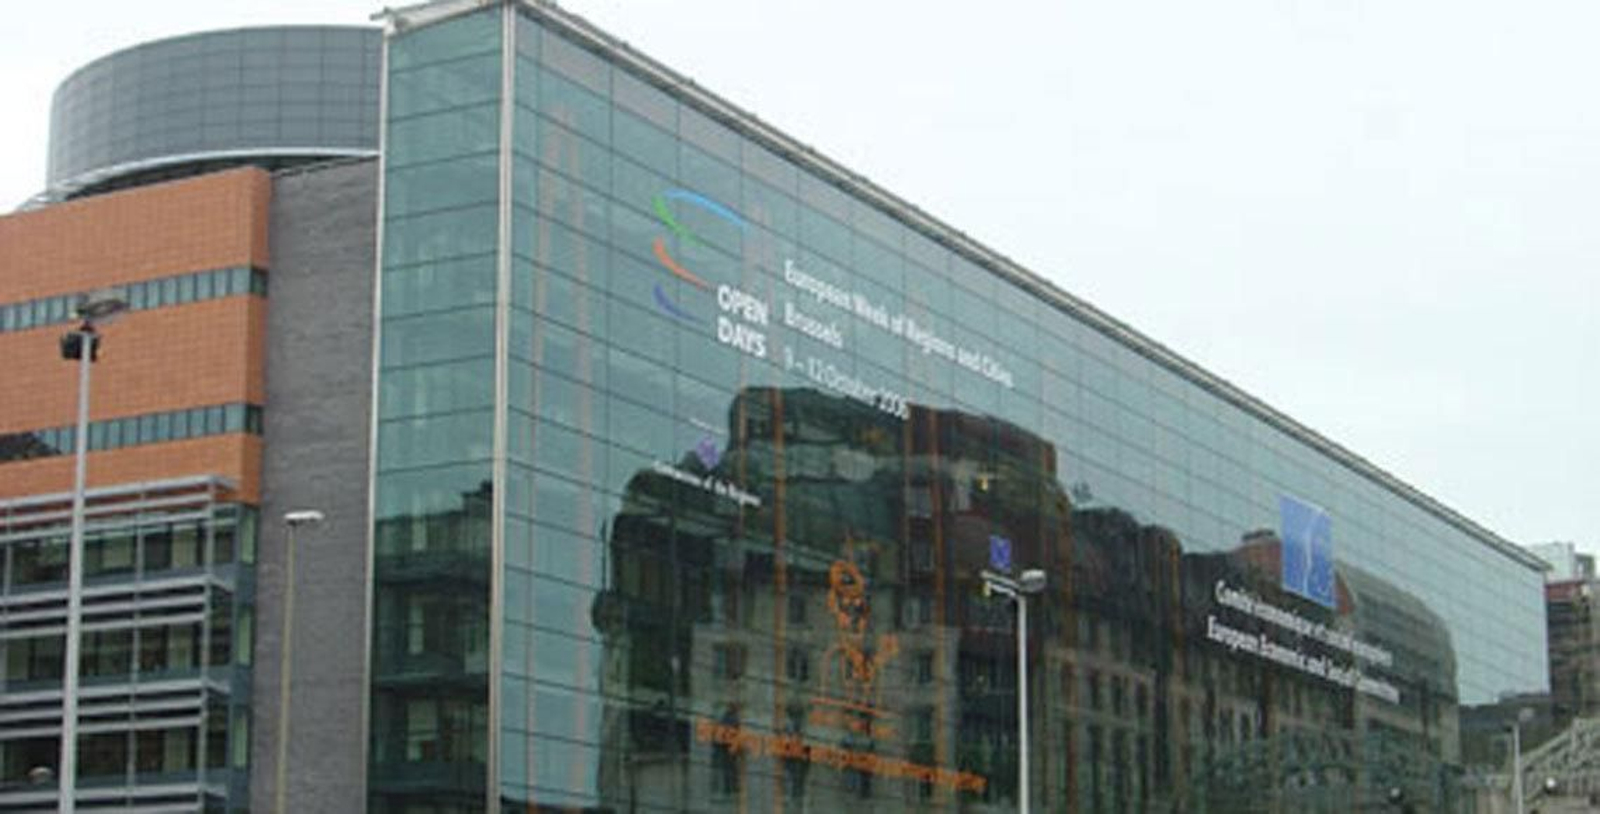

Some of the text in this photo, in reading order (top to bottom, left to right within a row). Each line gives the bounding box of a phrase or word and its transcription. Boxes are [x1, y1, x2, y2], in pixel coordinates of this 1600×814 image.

[717, 284, 769, 326] OPEN
[784, 259, 851, 311] European
[717, 316, 767, 358] DAYS
[784, 302, 843, 348] Brussels
